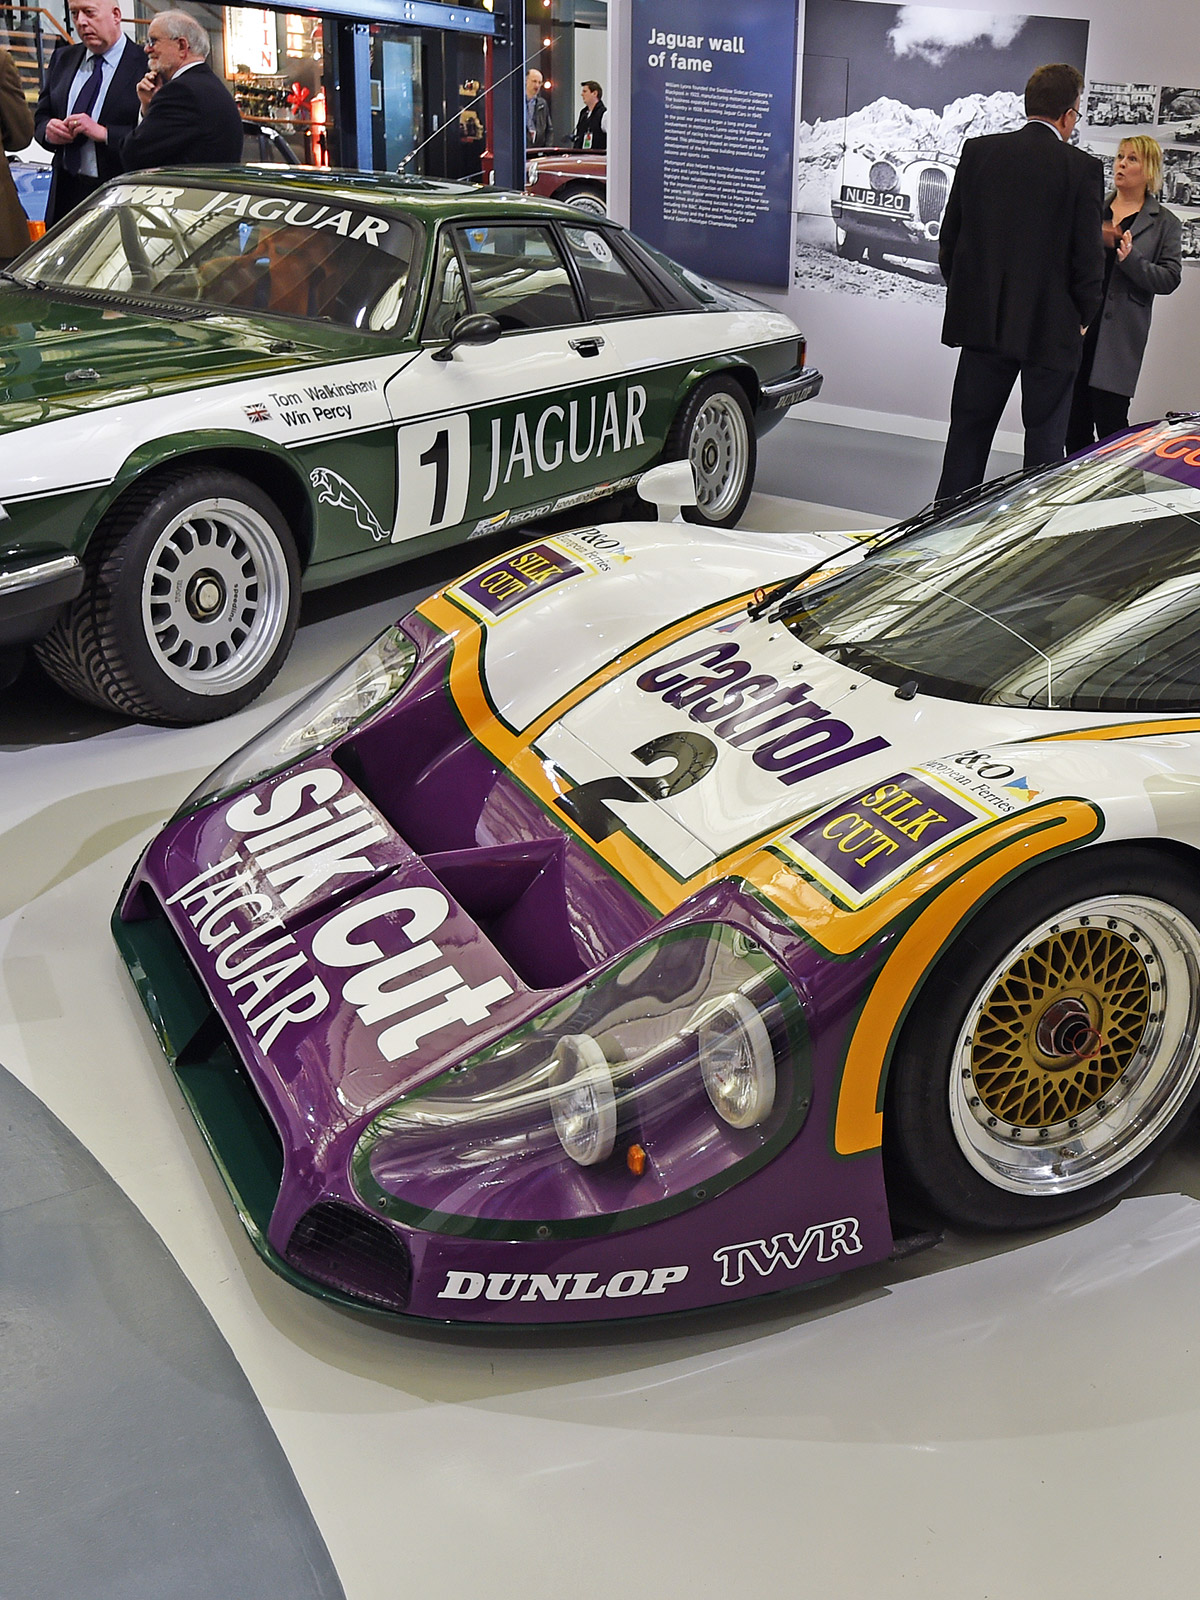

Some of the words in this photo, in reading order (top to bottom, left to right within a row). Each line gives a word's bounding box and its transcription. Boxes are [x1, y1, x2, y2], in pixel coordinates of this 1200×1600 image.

[648, 28, 703, 49] Jaguar
[709, 36, 745, 53] wall
[648, 51, 666, 67] of
[670, 53, 712, 72] fame
[846, 188, 876, 205] NUB
[879, 193, 904, 210] 120
[194, 191, 390, 247] JAGUAR
[268, 393, 303, 408] Tom
[303, 380, 378, 402] Walkinshaw
[280, 411, 311, 427] Win
[312, 404, 352, 421] Percy
[483, 384, 648, 503] JAGUAR
[419, 429, 449, 526] 1
[506, 504, 551, 526] RECARO
[556, 535, 588, 557] European
[585, 550, 613, 573] Ferries
[572, 527, 621, 550] P&O
[479, 570, 528, 601] CUT
[509, 552, 564, 585] SILK
[228, 583, 239, 623] speedline
[636, 642, 892, 787] Castrol
[944, 749, 1015, 780] P&O
[555, 731, 718, 844] 2
[969, 782, 1016, 814] Ferries
[861, 783, 948, 842] SILK
[822, 812, 899, 868] CUT
[225, 767, 388, 911] Silk
[311, 886, 515, 1062] Cut
[165, 851, 331, 1057] JAGUAR
[712, 1217, 863, 1287] TWR
[437, 1265, 689, 1302] DUNLOP
